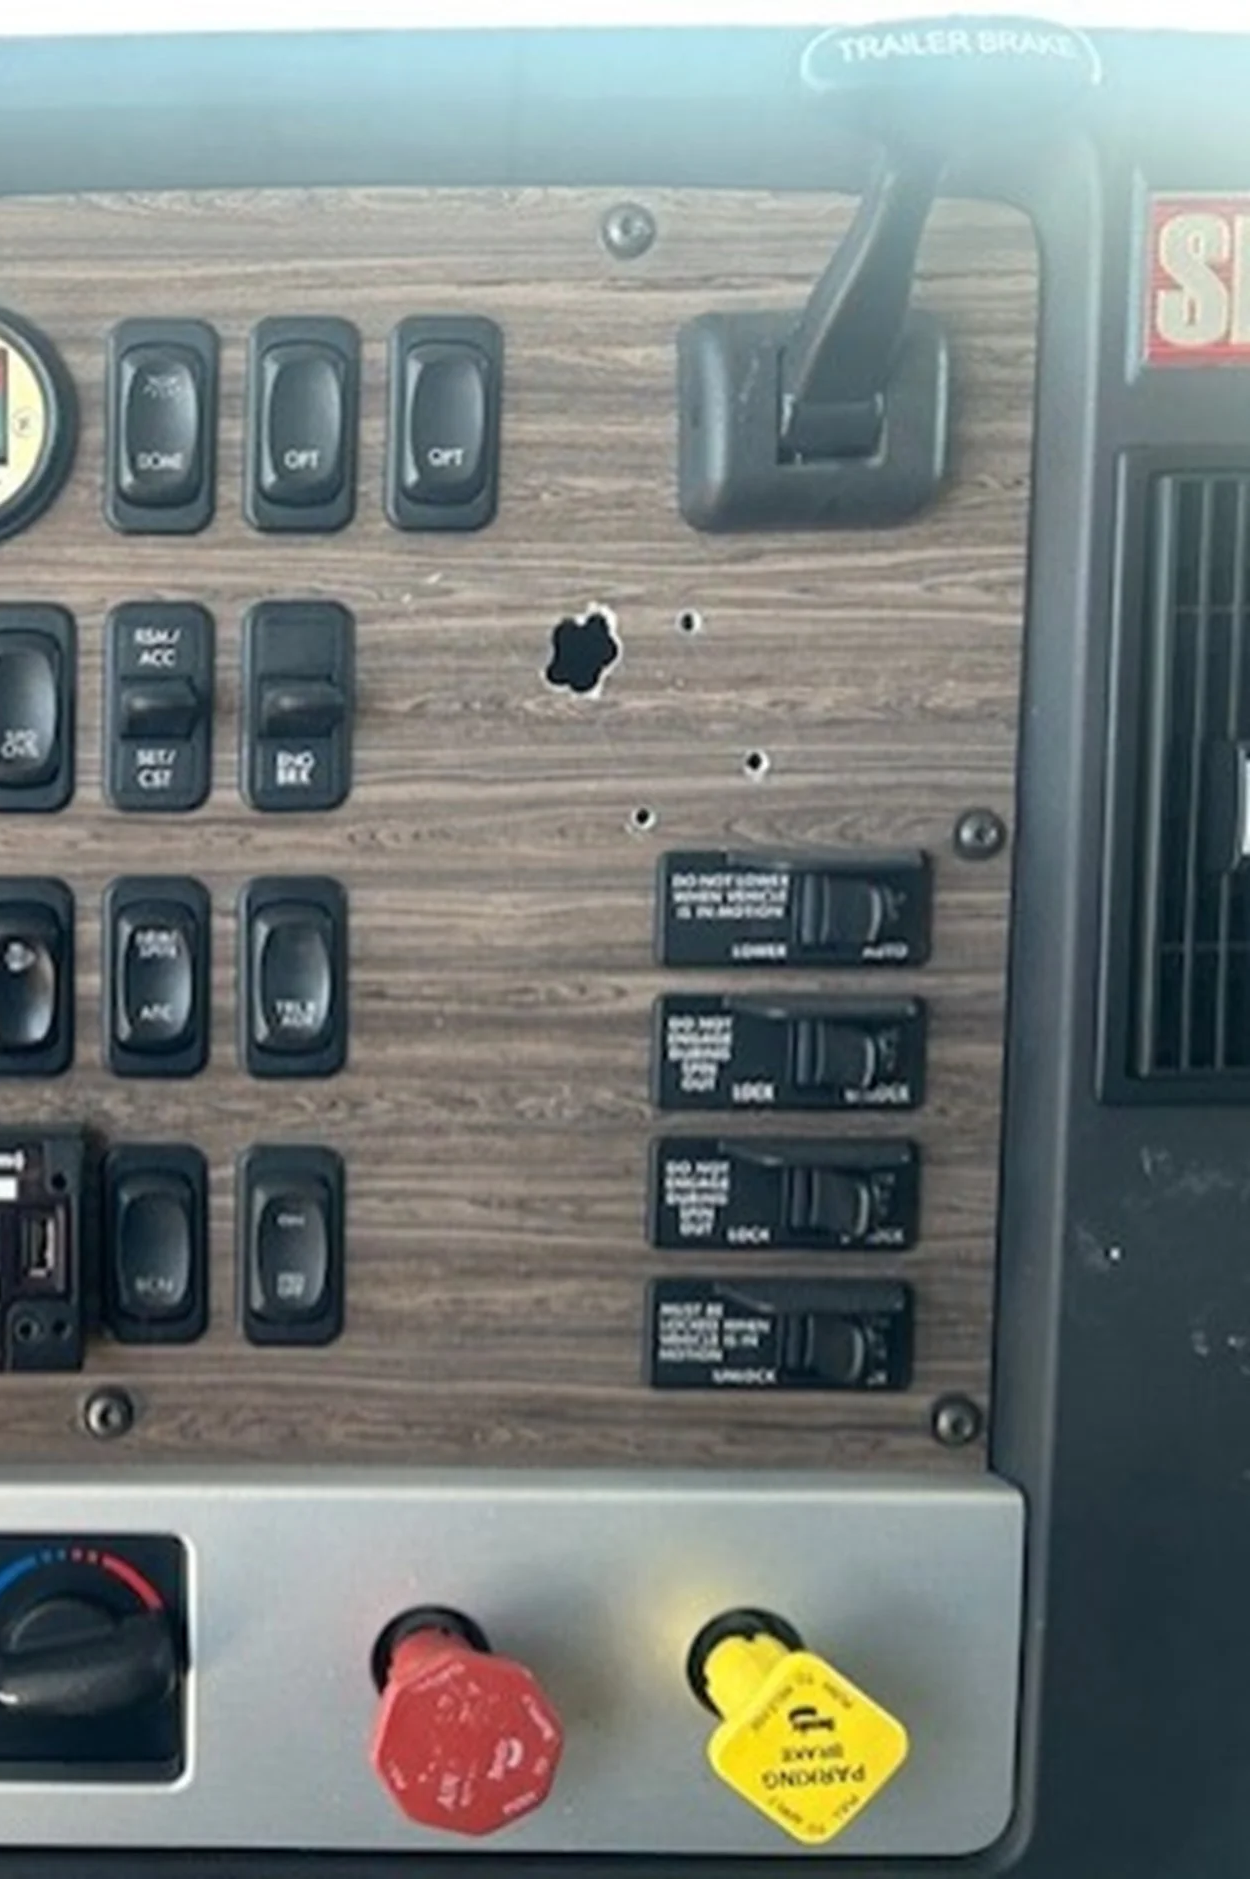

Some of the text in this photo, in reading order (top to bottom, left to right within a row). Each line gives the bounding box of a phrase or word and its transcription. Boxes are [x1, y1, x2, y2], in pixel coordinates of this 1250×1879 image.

[837, 28, 1079, 63] TRAILER BRAKE
[1155, 212, 1250, 348] S
[283, 450, 320, 471] OPT
[427, 446, 465, 468] OPT
[139, 650, 177, 668] ACC
[137, 748, 177, 767] SET/
[137, 768, 173, 789] CST
[671, 873, 789, 889] DO NOT LOWER
[673, 888, 787, 903] WHEN VEHICLE
[718, 904, 784, 918] MOTION
[731, 942, 787, 959] LOWER
[667, 1015, 733, 1031] DO NOT
[667, 1032, 732, 1045] ENGAGE
[667, 1047, 731, 1061] DURING
[732, 1082, 775, 1102] LOCK
[665, 1161, 730, 1175] DO NOT
[727, 1226, 770, 1245] LOCK
[660, 1303, 724, 1317] MUST BE
[723, 1319, 770, 1333] WHEN
[659, 1350, 724, 1364] MOTION
[712, 1368, 777, 1386] UNLOCK
[781, 1743, 844, 1762] BRAKE
[761, 1763, 867, 1790] PARKING
